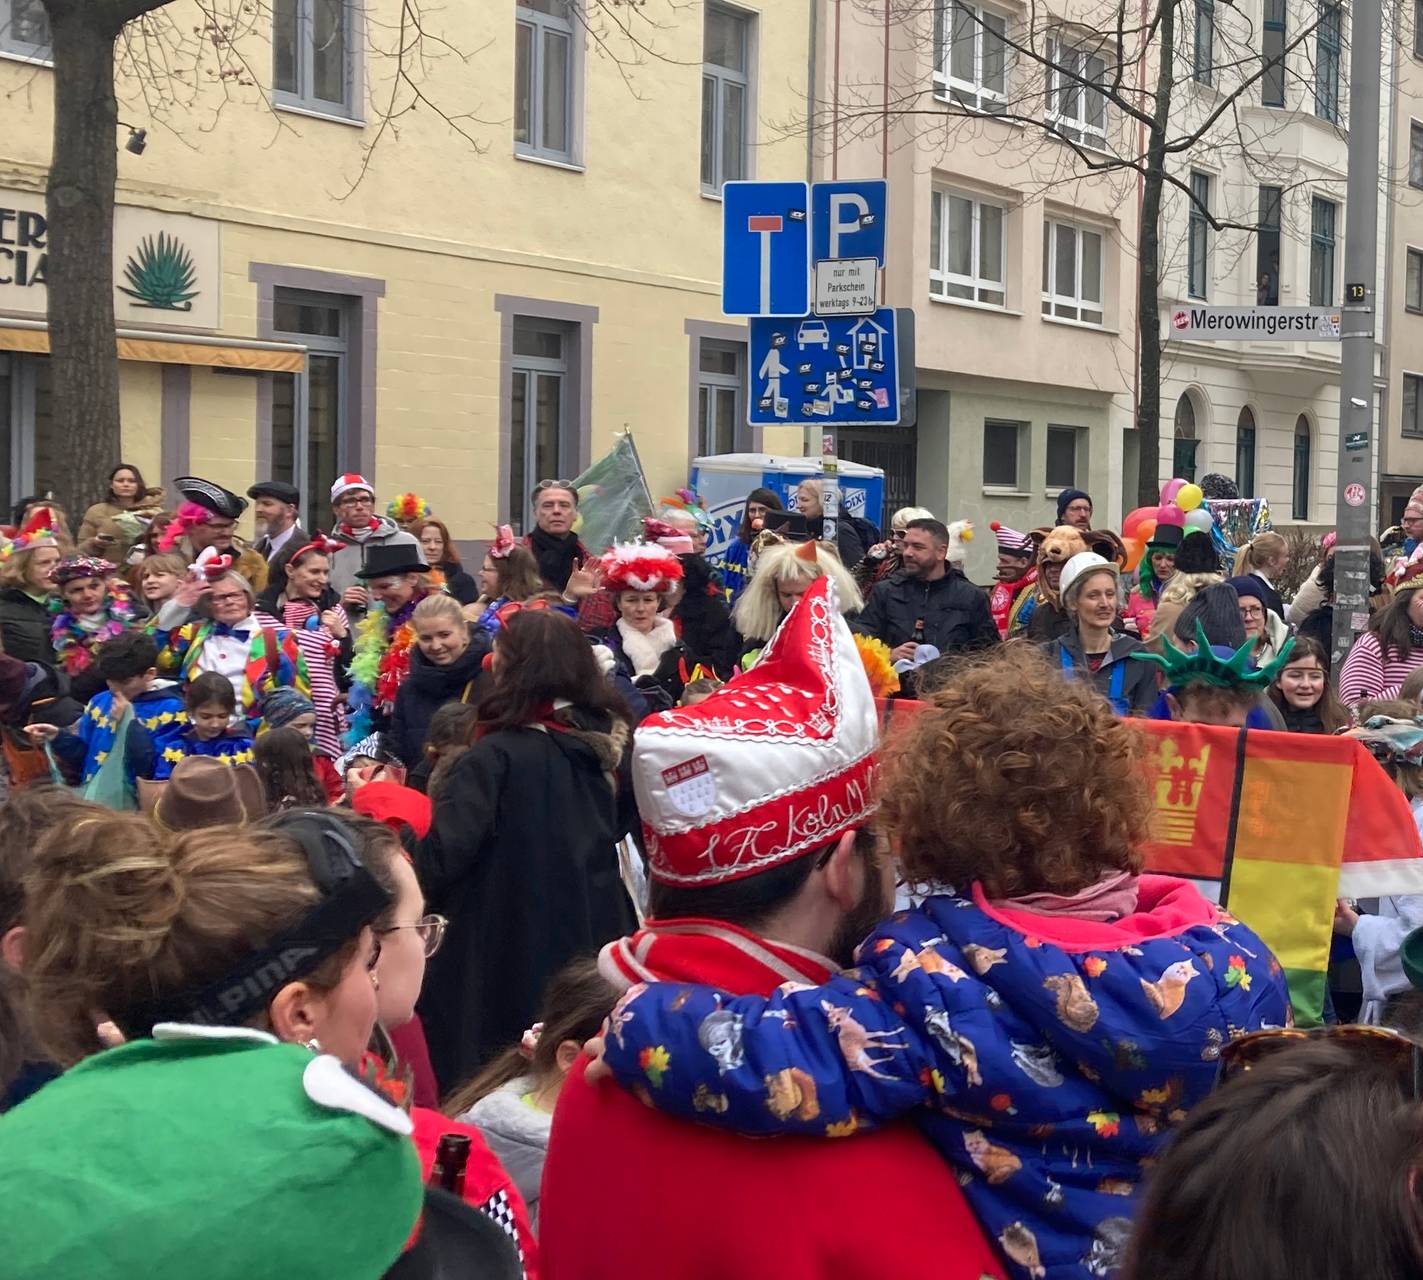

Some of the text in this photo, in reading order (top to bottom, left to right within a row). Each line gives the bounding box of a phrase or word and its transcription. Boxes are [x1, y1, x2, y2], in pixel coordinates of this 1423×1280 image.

[833, 268, 860, 277] nur mit
[827, 282, 865, 292] Parkschein
[1351, 286, 1364, 297] 13
[819, 298, 849, 309] werktags
